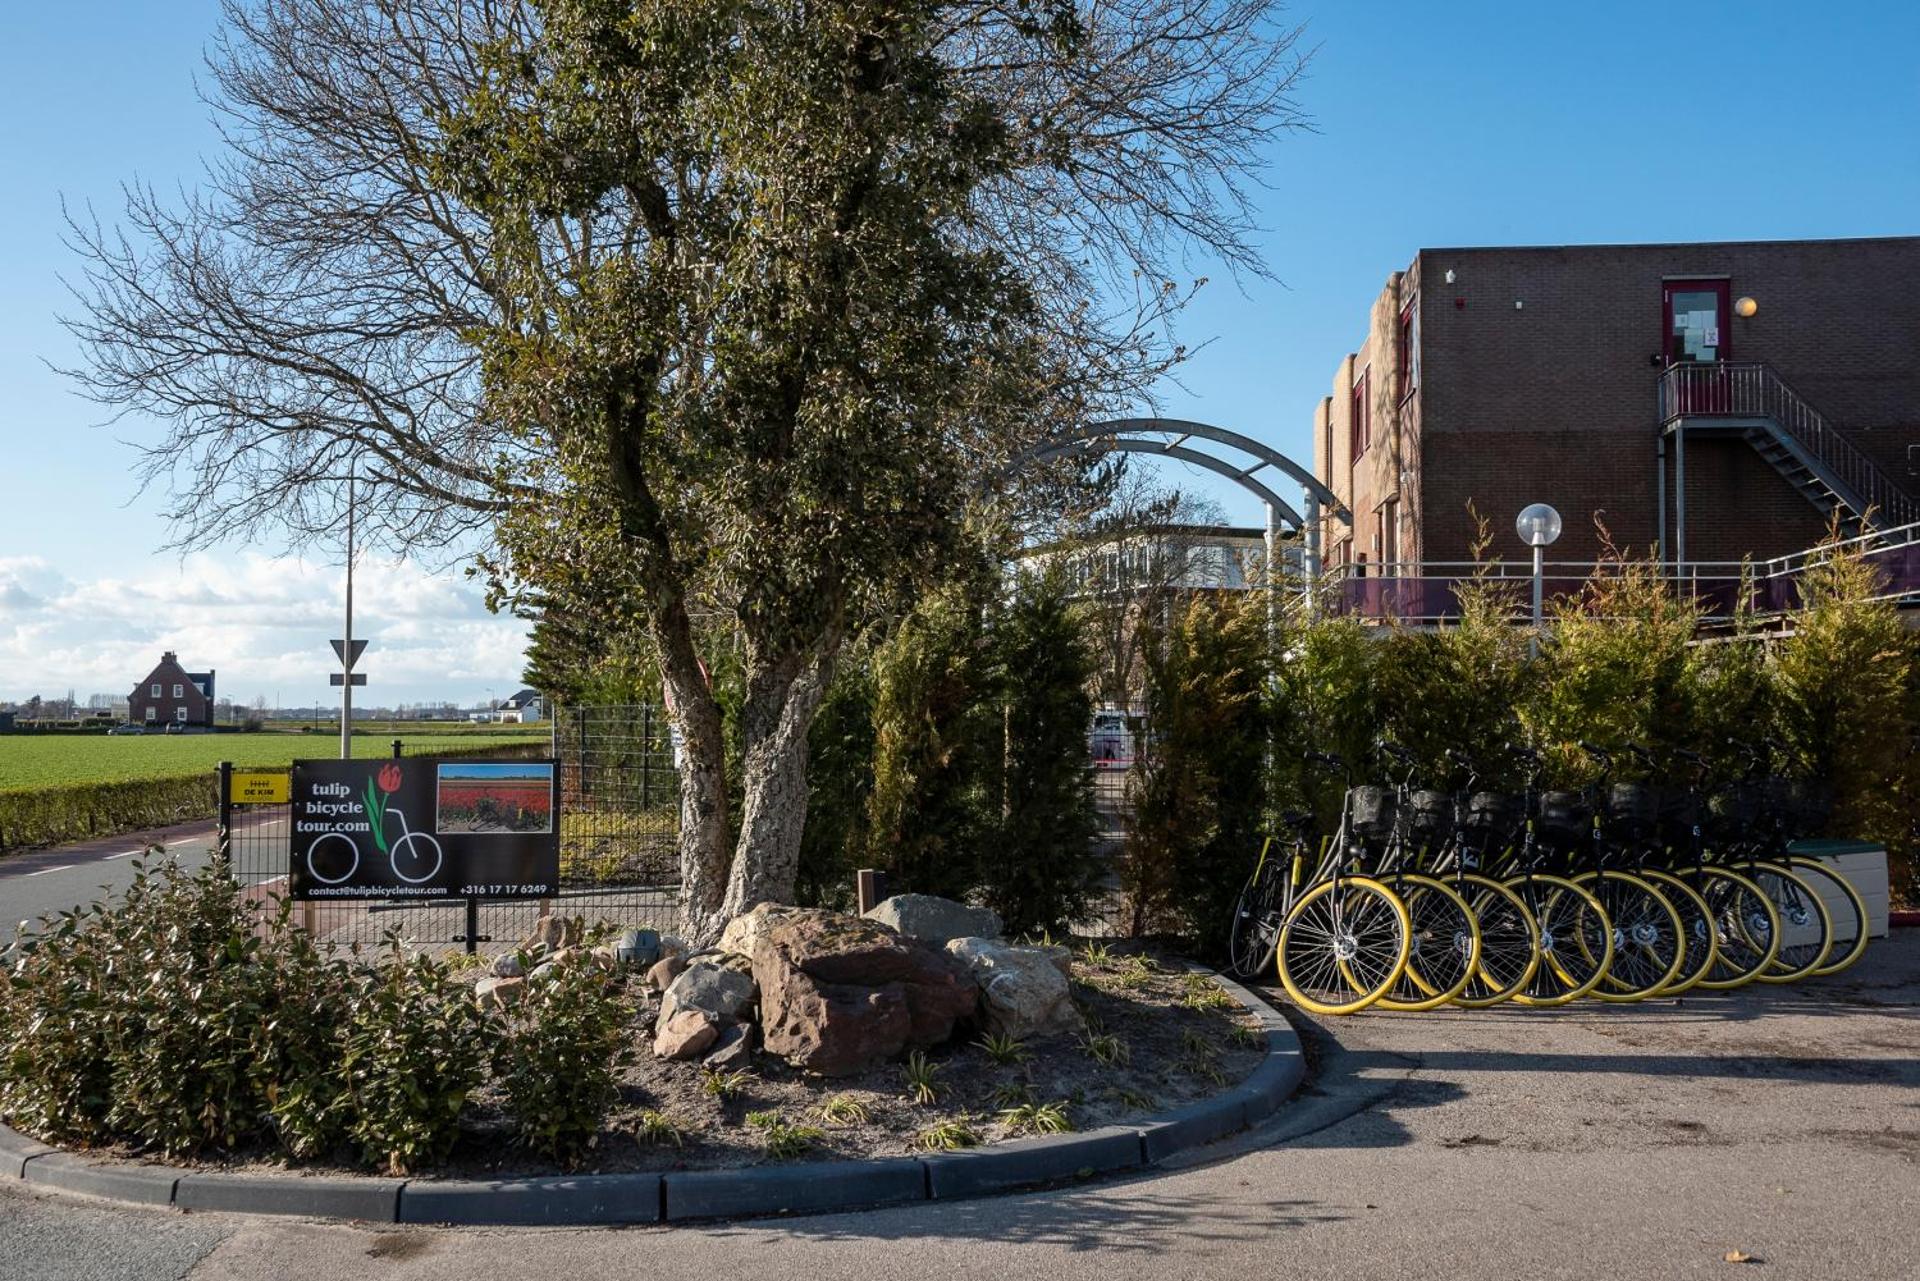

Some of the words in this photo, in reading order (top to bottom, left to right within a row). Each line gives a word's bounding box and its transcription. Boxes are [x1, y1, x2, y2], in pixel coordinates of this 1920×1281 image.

[312, 782, 350, 798] tulip
[306, 801, 363, 817] bicycle
[296, 820, 370, 832] tour.com
[308, 885, 447, 897] contact@tulipbicycletour.com
[460, 885, 486, 894] +316
[489, 885, 502, 894] 17
[505, 885, 518, 894] 17
[520, 884, 547, 894] 6249
